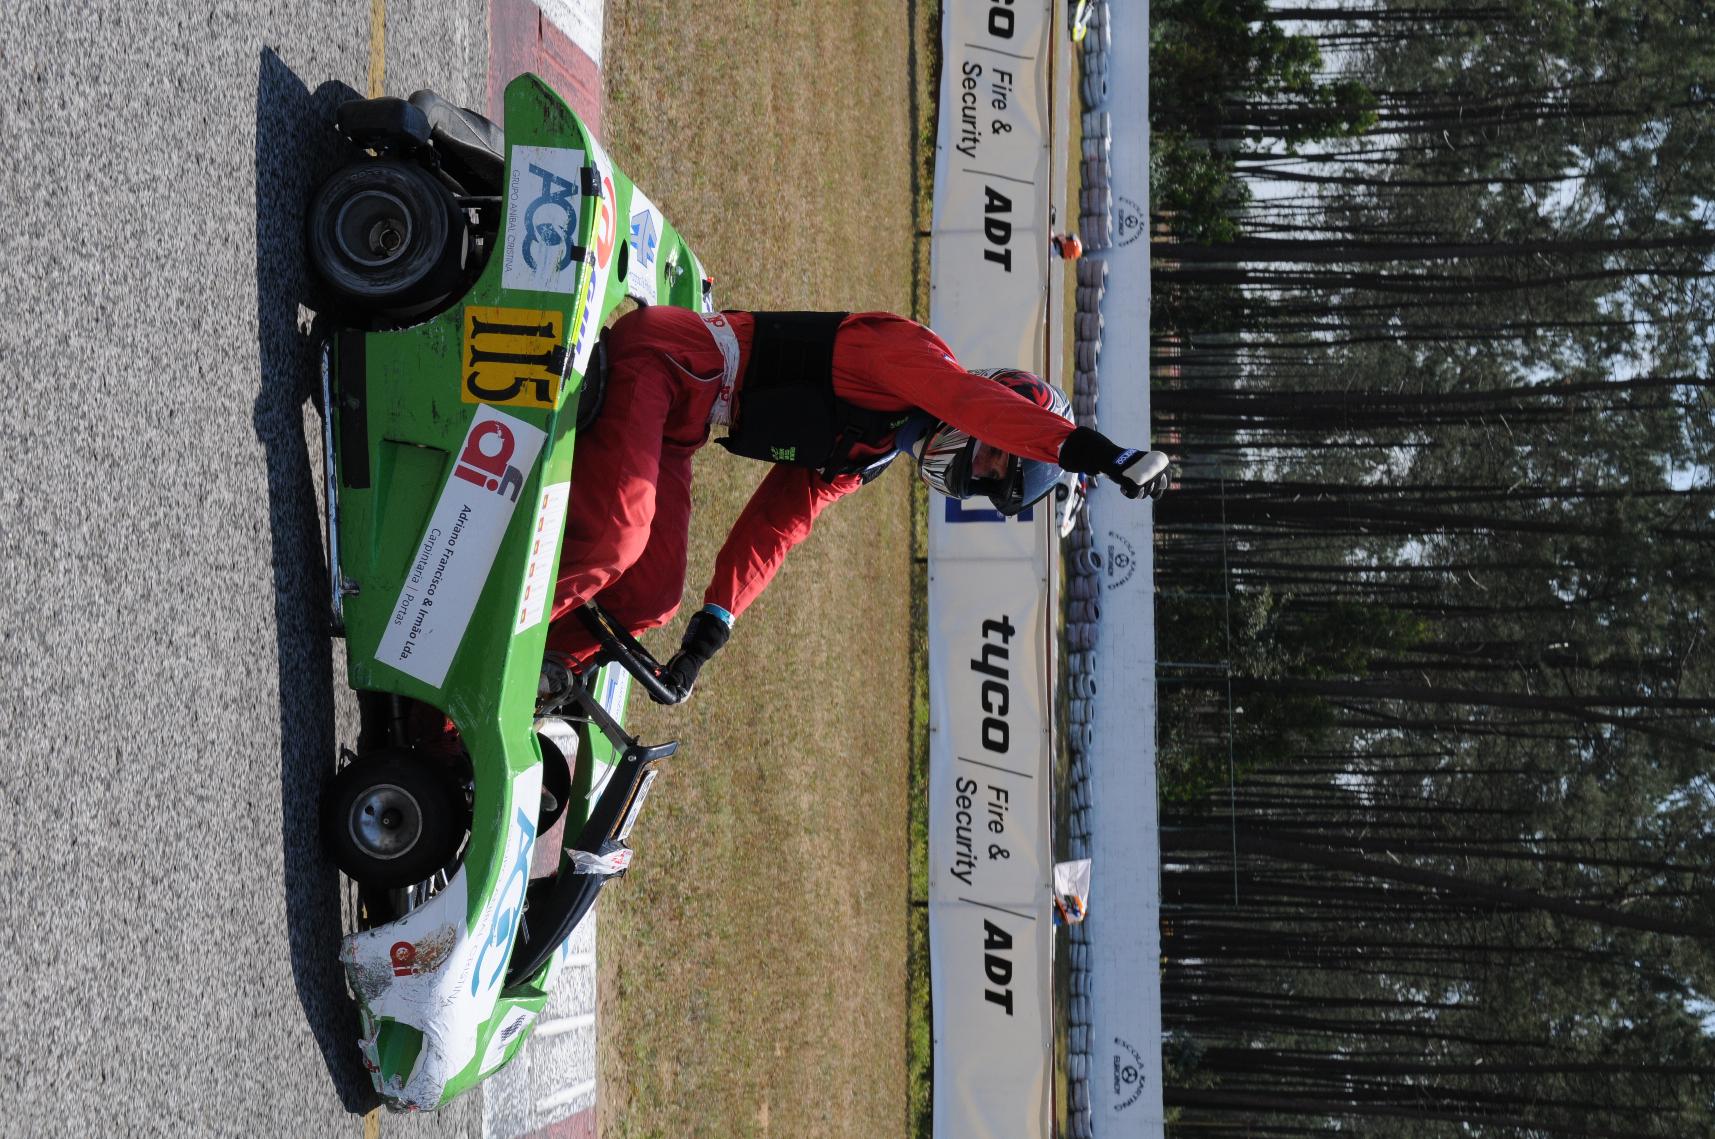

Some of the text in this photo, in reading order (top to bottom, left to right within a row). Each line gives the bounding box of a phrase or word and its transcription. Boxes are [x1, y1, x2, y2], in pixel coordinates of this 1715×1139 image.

[955, 61, 983, 159] Security
[991, 68, 1013, 135] Fire &
[510, 169, 521, 201] GRUPO
[983, 185, 1013, 273] ADT
[504, 235, 516, 273] CRISTINA
[465, 315, 557, 403] 115
[398, 504, 472, 661] Adriano Francisco & Irmão Lda.
[410, 528, 442, 584] Carpintaria
[394, 593, 415, 626] Portas
[970, 614, 1016, 754] tyco
[950, 776, 978, 886] Security
[987, 784, 1011, 861] Fire &
[983, 918, 1014, 1016] ADT
